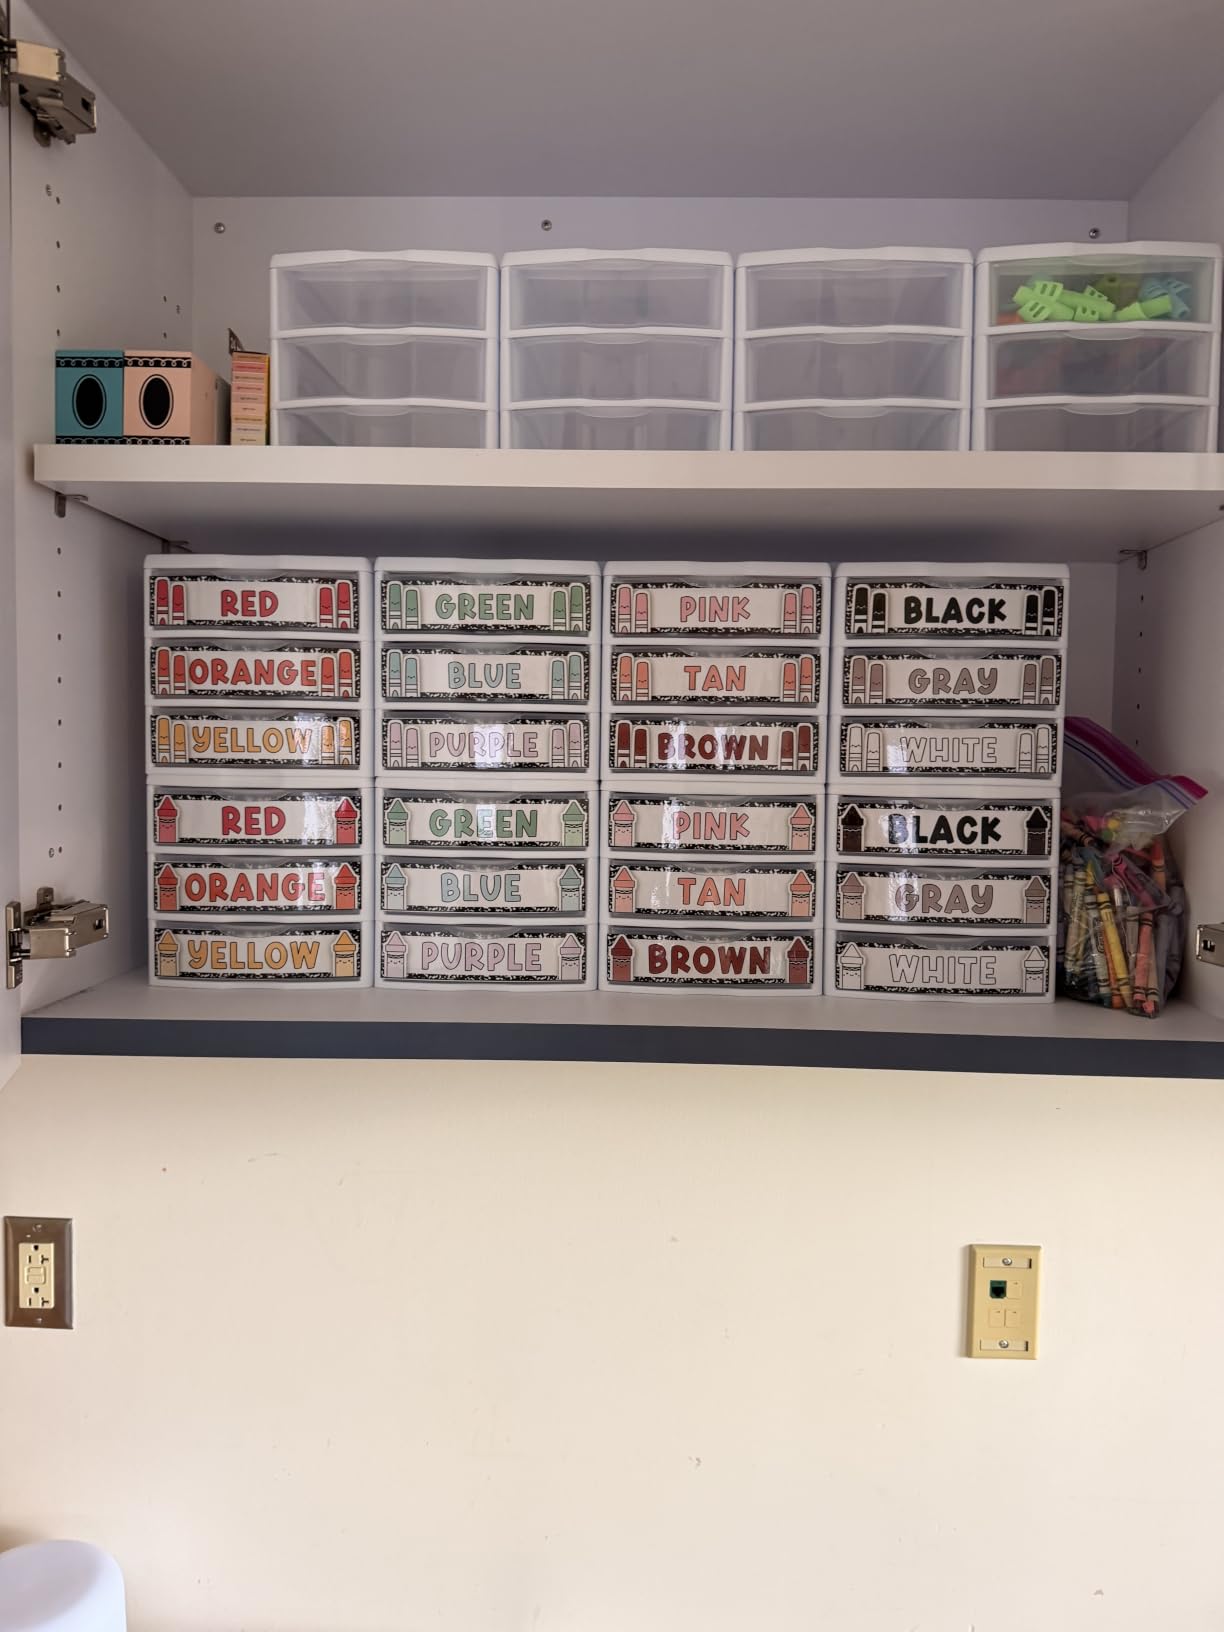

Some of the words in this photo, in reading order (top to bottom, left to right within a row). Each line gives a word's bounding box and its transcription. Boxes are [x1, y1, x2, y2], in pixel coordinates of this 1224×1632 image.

[221, 589, 279, 617] RED
[435, 593, 534, 620] GREEN
[680, 595, 751, 622] PINK
[904, 596, 1007, 624] BLACK
[189, 658, 317, 686] ORANGE
[448, 661, 521, 689] BLUE
[684, 665, 746, 691] TAN
[908, 667, 998, 695] GRAY
[192, 726, 312, 753] YELLOW
[429, 732, 538, 758] PURPLE
[657, 733, 769, 761] BROWN
[900, 736, 997, 763] WHITE
[221, 806, 286, 836] RED
[429, 809, 537, 838] GREEN
[673, 811, 750, 841] PINK
[888, 813, 1002, 845] BLACK
[185, 873, 326, 902] ORANGE
[441, 872, 521, 902] BLUE
[678, 877, 746, 906] TAN
[895, 883, 994, 914] GRAY
[187, 940, 320, 970] YELLOW
[422, 942, 542, 972] PURPLE
[648, 944, 771, 975] BROWN
[889, 954, 997, 985] WHITE
